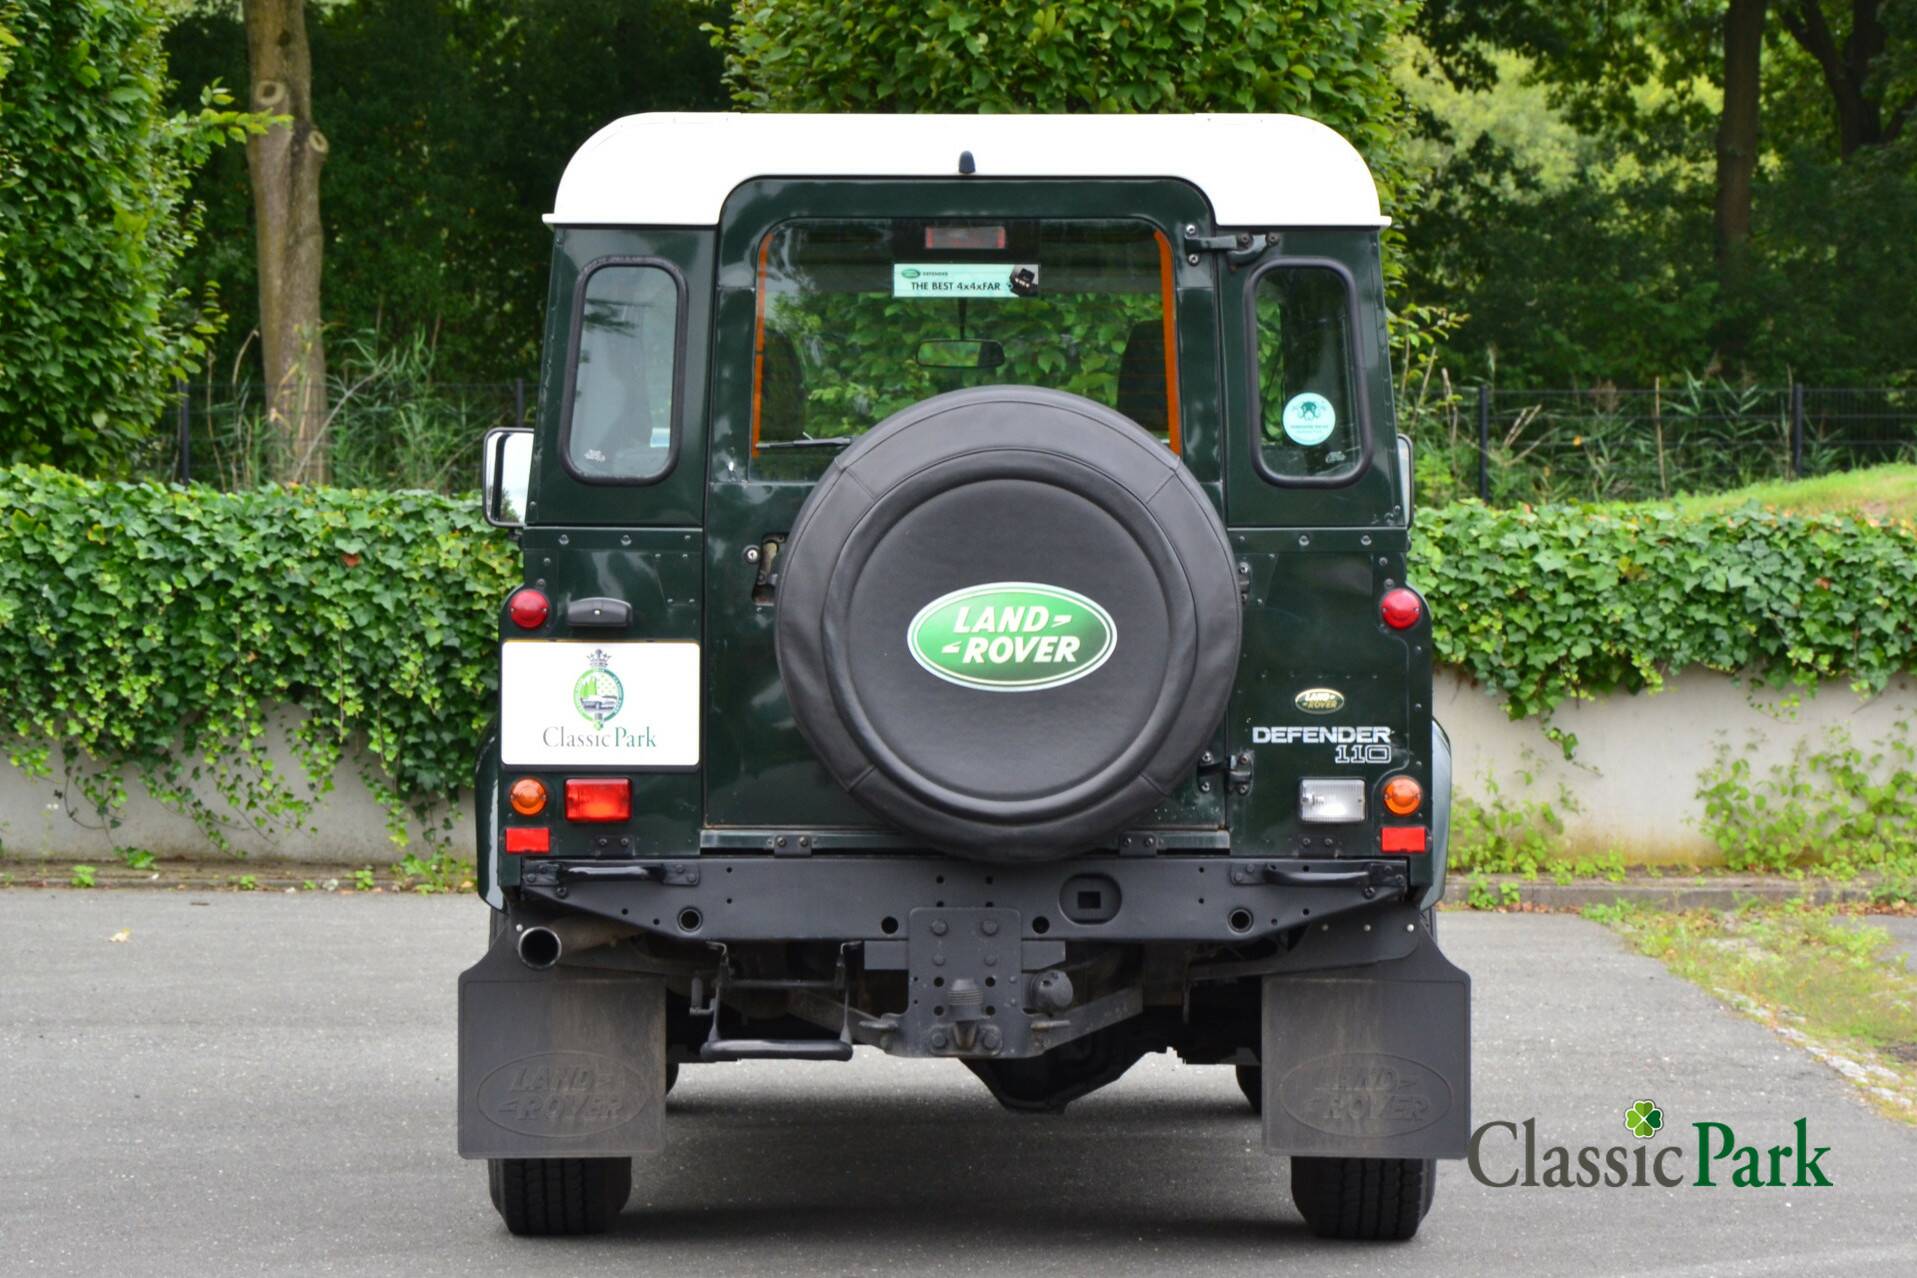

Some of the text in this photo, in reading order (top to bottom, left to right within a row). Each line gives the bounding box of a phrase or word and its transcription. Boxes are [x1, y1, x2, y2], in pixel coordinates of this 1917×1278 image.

[911, 282, 1001, 291] THE BEST 4x4xFAR
[953, 605, 1049, 634] LAND
[962, 635, 1081, 664] ROVER
[1307, 700, 1338, 709] ROVER
[542, 726, 657, 748] Classic Park
[1252, 726, 1392, 744] DEFENDER
[1335, 744, 1392, 764] 110
[510, 1066, 594, 1093] LAND
[516, 1094, 626, 1121] ROVER
[1322, 1094, 1431, 1121] ROVER
